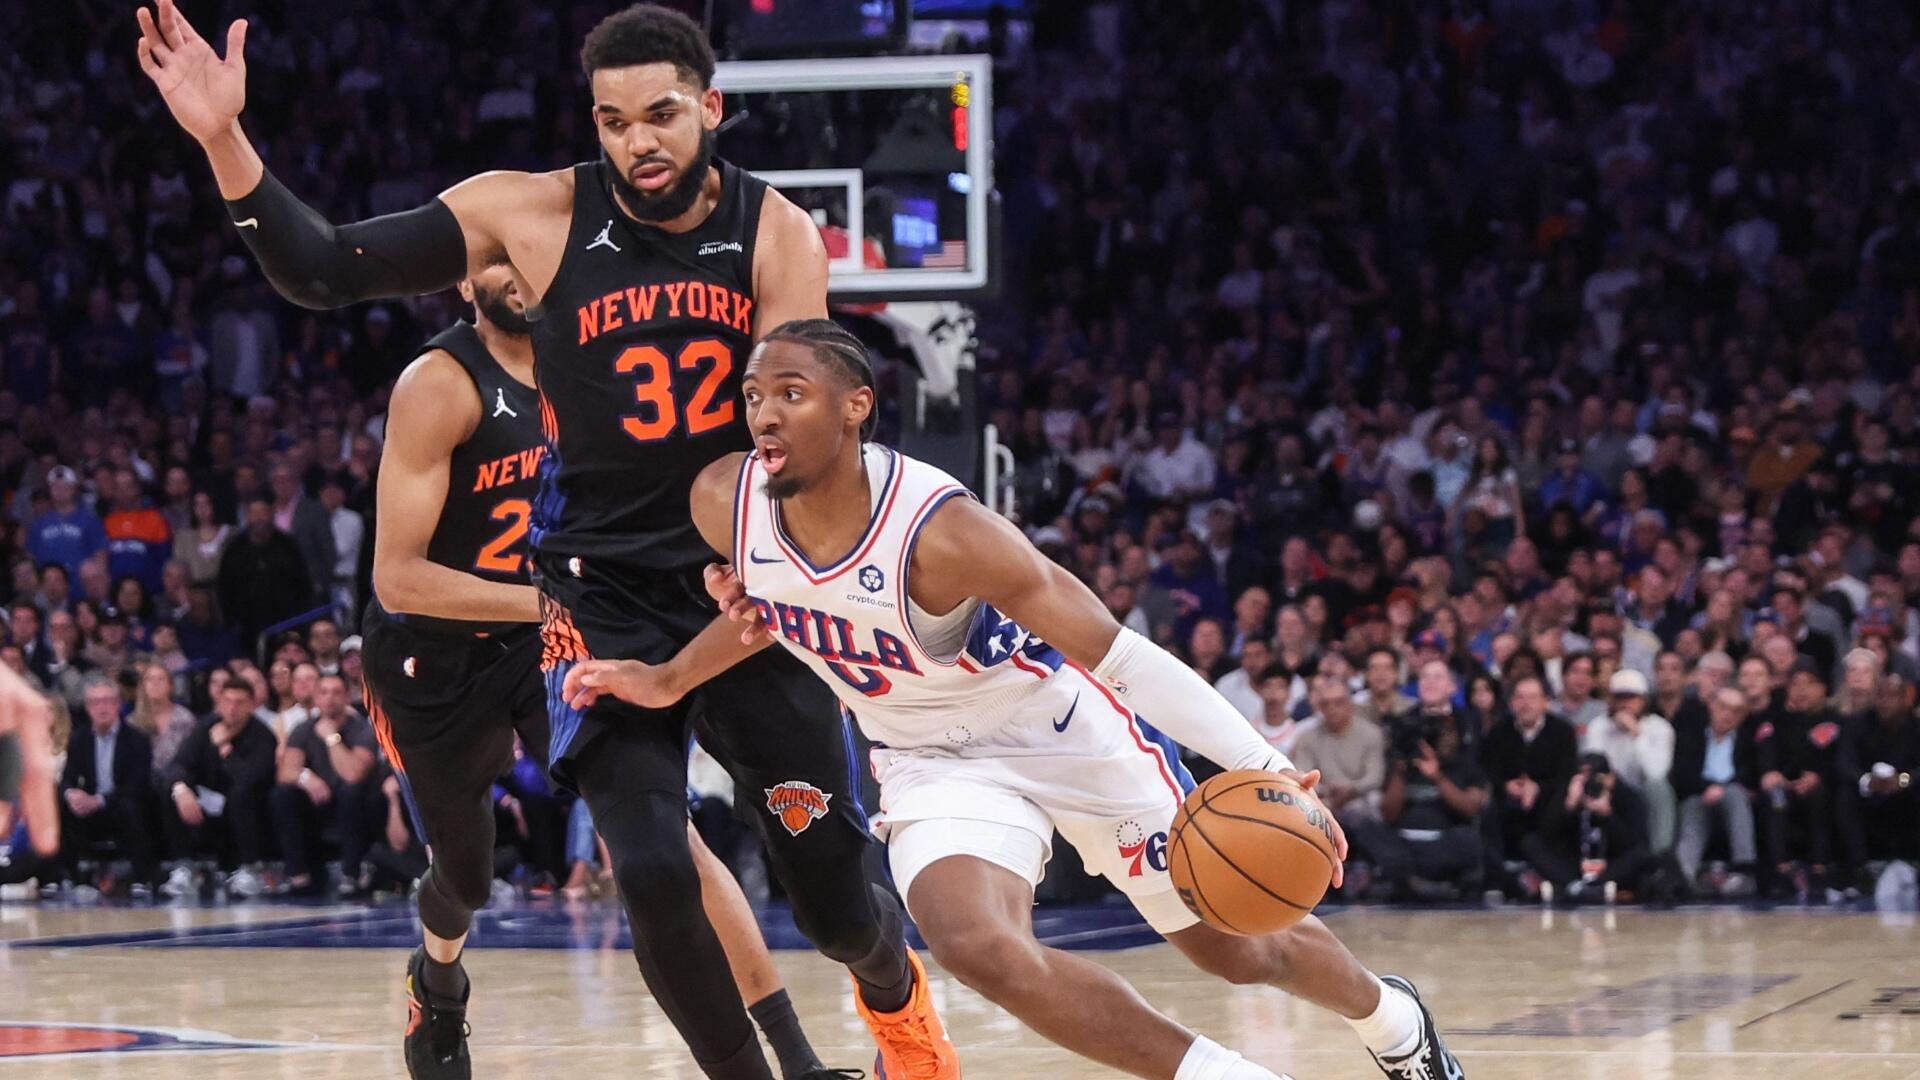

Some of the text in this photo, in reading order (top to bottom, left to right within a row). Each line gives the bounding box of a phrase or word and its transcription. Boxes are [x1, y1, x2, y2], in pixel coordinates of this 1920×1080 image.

[577, 281, 752, 346] NEW YORK
[614, 338, 736, 442] 32
[472, 445, 547, 493] NEW
[474, 497, 535, 574] 2
[846, 594, 896, 609] crypto.com
[1118, 831, 1168, 878] 76
